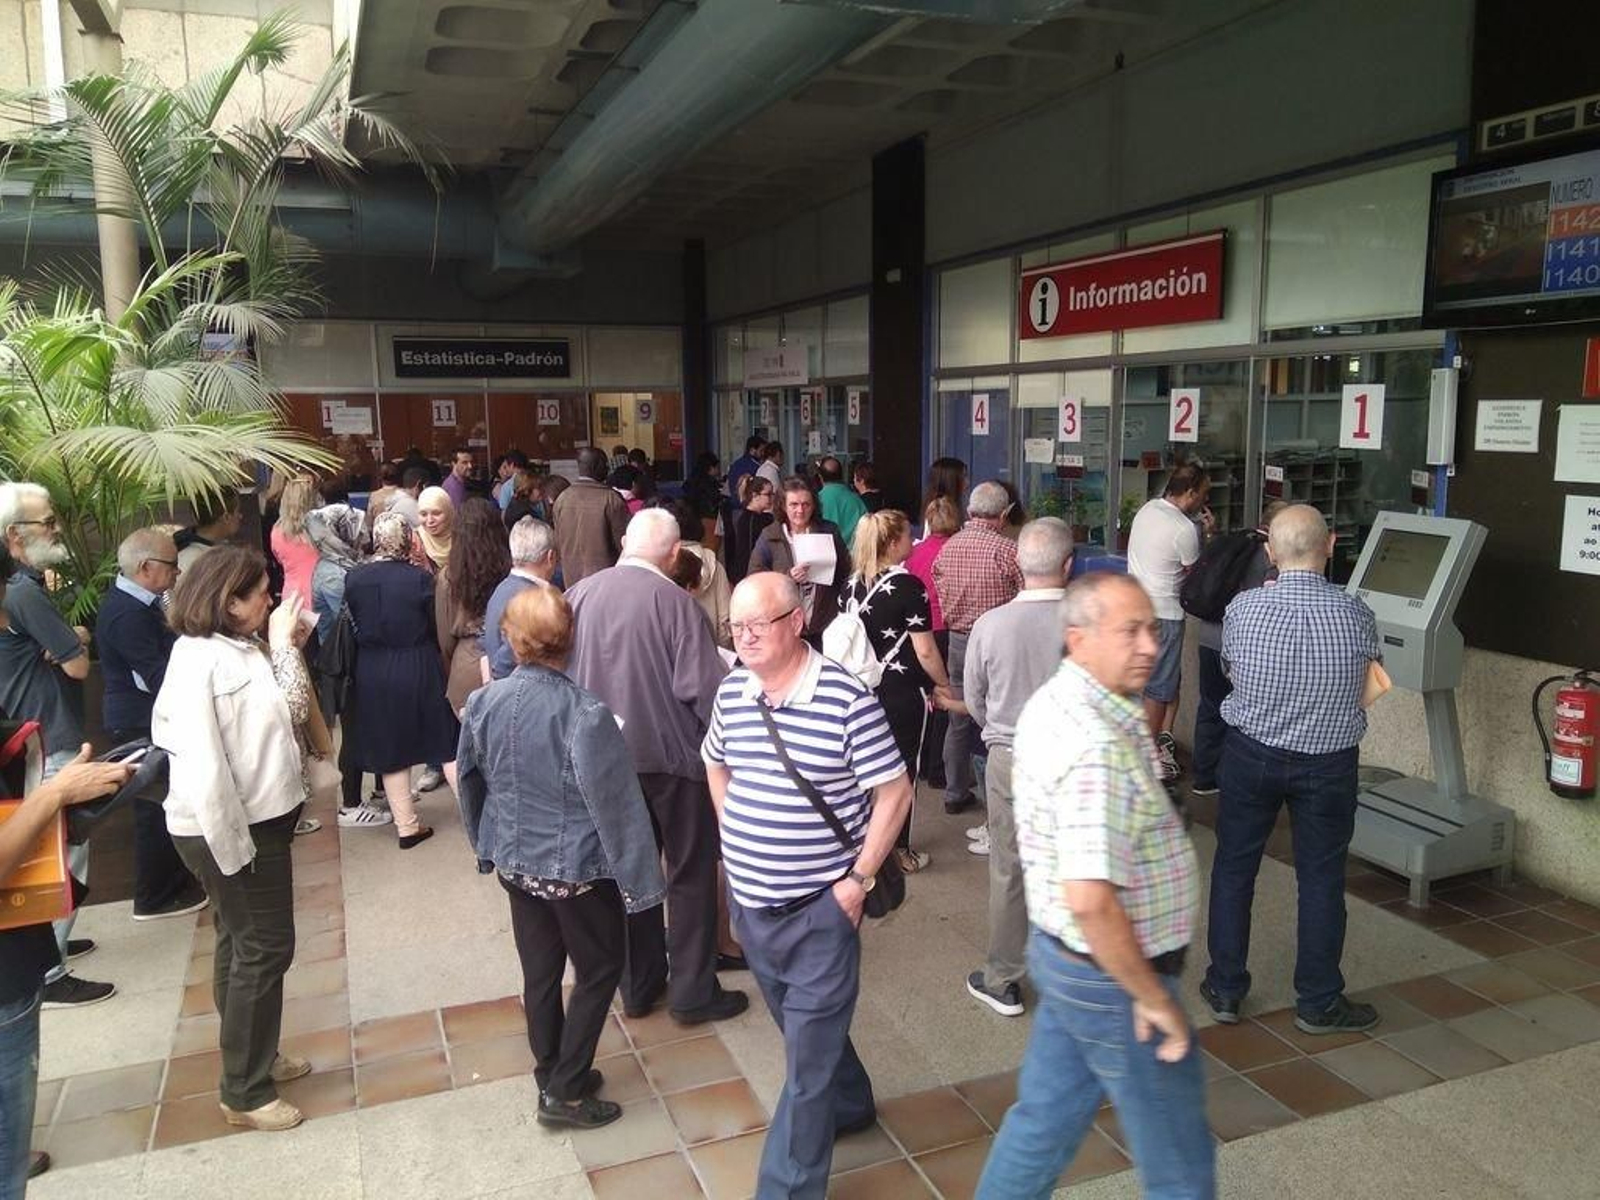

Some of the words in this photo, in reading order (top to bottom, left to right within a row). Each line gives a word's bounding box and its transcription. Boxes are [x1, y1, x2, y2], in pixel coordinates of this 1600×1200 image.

[1069, 266, 1207, 311] Información
[434, 406, 455, 422] 11
[540, 404, 559, 421] 10
[639, 402, 652, 420] 9
[802, 399, 810, 421] 6
[850, 396, 858, 420] 5
[974, 401, 987, 429] 4
[1063, 402, 1076, 435] 3
[1174, 395, 1192, 434] 2
[1352, 394, 1370, 440] 1
